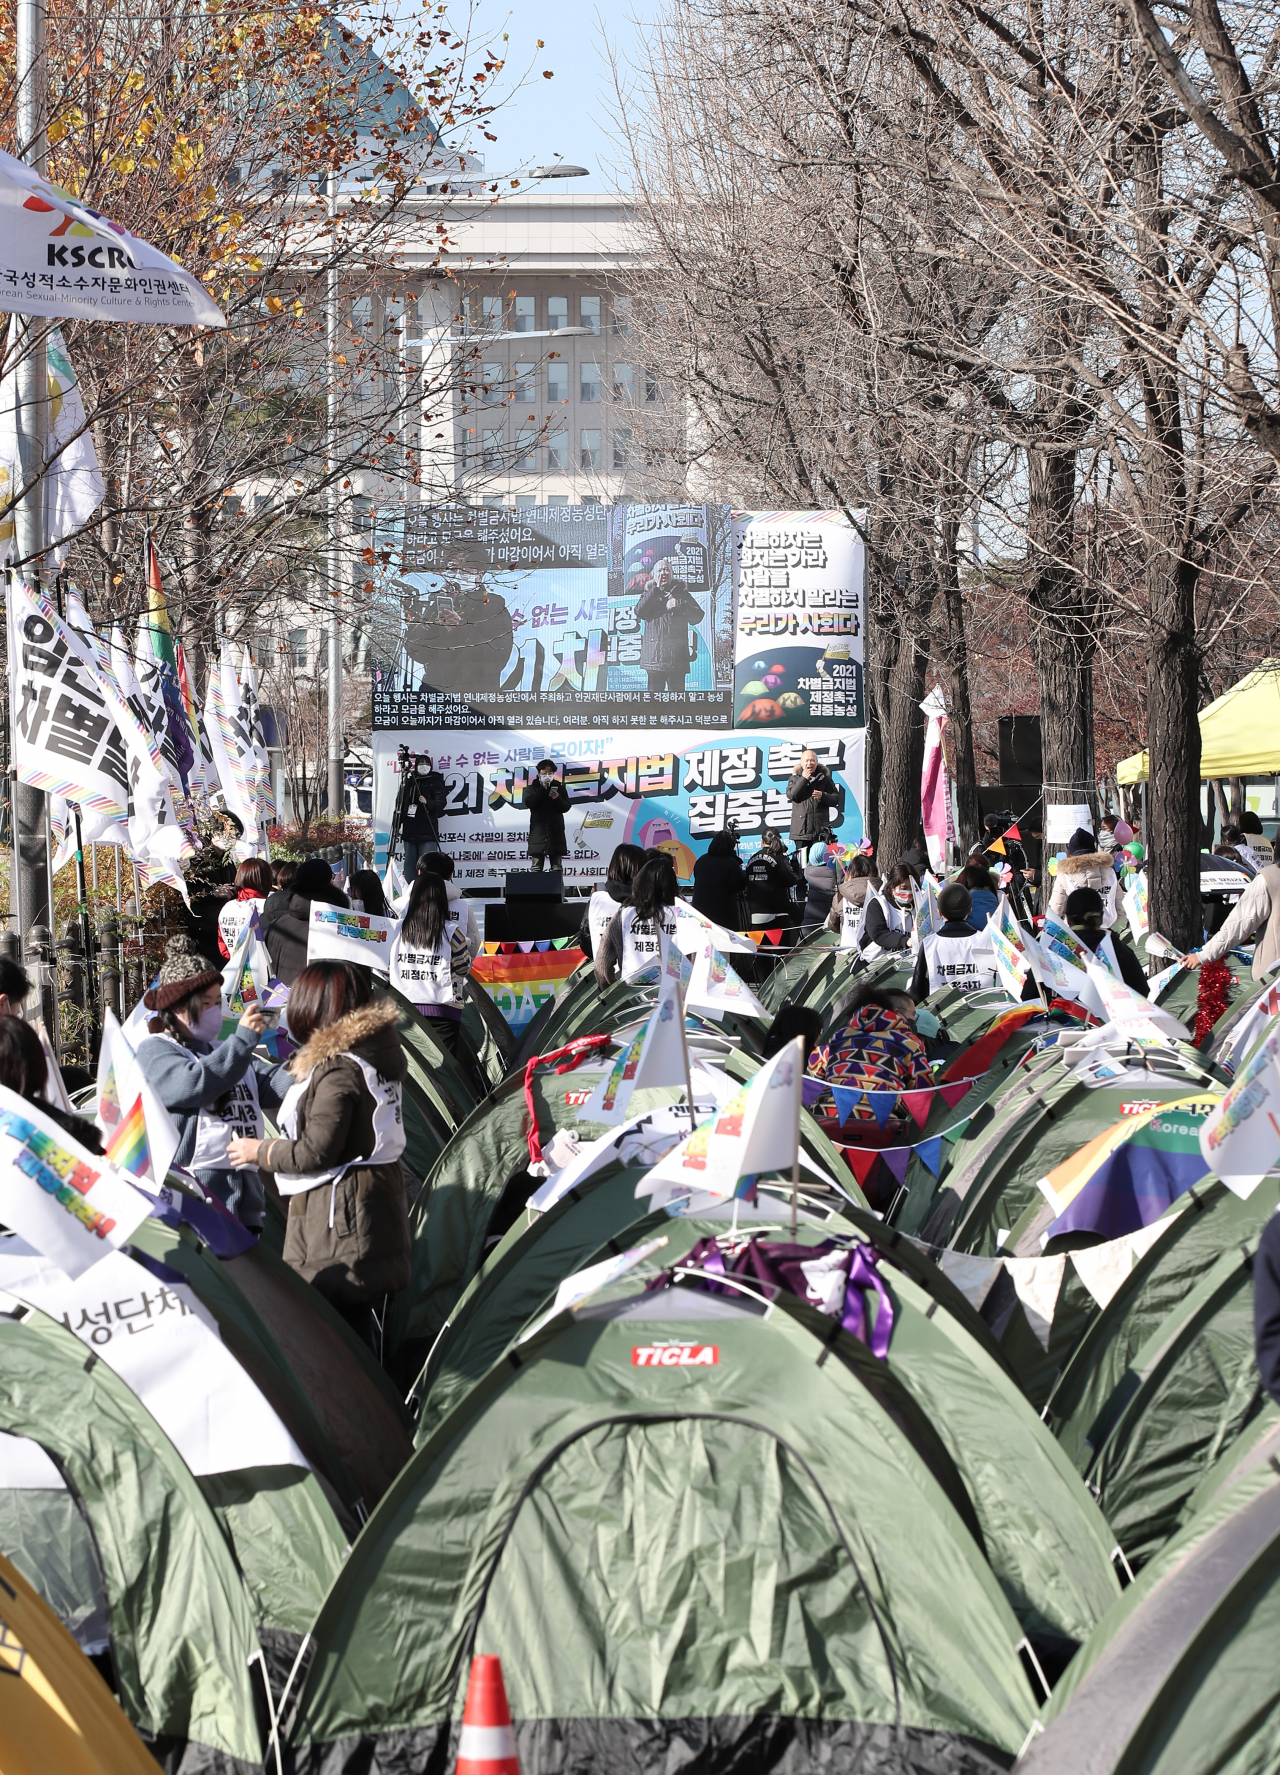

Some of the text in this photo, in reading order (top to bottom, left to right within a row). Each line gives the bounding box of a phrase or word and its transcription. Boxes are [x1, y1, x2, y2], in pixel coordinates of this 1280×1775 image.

[0, 268, 191, 297] 국성적소수자문화인권센터
[26, 290, 98, 307] Sexual-Minority
[101, 296, 133, 306] Culture
[135, 297, 142, 306] &
[144, 297, 171, 309] Rights
[736, 530, 823, 549] 차별하자는
[498, 544, 556, 563] 마감이어서
[558, 544, 583, 561] 아직
[738, 550, 828, 568] 정치는 가라
[739, 569, 790, 588] 사람을
[739, 588, 859, 609] 차별하지 말라는
[531, 602, 570, 629] 없는
[737, 612, 860, 637] 우리가 사회다
[832, 664, 857, 677] 2021
[797, 677, 857, 691] 차별금지법
[374, 692, 724, 704] 오늘 행사는 차별금지법 연내제정농성단에서 주최하고 인권재단사람에서 돈 걱정하지 말고 농성
[809, 690, 857, 704] 제정촉구
[374, 704, 472, 715] 하라고 모금을 해주셨어요.
[809, 703, 858, 718] 집중농성
[374, 715, 399, 726] 모금이
[401, 715, 443, 726] 오늘까지가
[445, 715, 486, 726] 마감이어서
[488, 715, 505, 726] 아직
[506, 715, 523, 726] 열려
[526, 715, 561, 726] 있습니다,
[593, 715, 609, 725] 아직
[611, 715, 628, 725] 하지
[630, 715, 647, 725] 못한
[649, 715, 658, 725] 분
[660, 715, 693, 725] 해주시고
[438, 755, 452, 770] 살
[455, 754, 469, 768] 수
[472, 751, 500, 767] 없는
[504, 745, 545, 762] 사람들
[683, 745, 763, 792] 제정
[487, 850, 516, 861] 살아도
[465, 868, 485, 878] 제정
[315, 910, 371, 929] 차별금지법
[337, 924, 387, 943] 제정하라!
[397, 953, 443, 966] 차별금지법
[400, 969, 439, 982] 제정하자
[936, 963, 979, 976] 차별금지
[636, 1346, 714, 1366] TICLA
